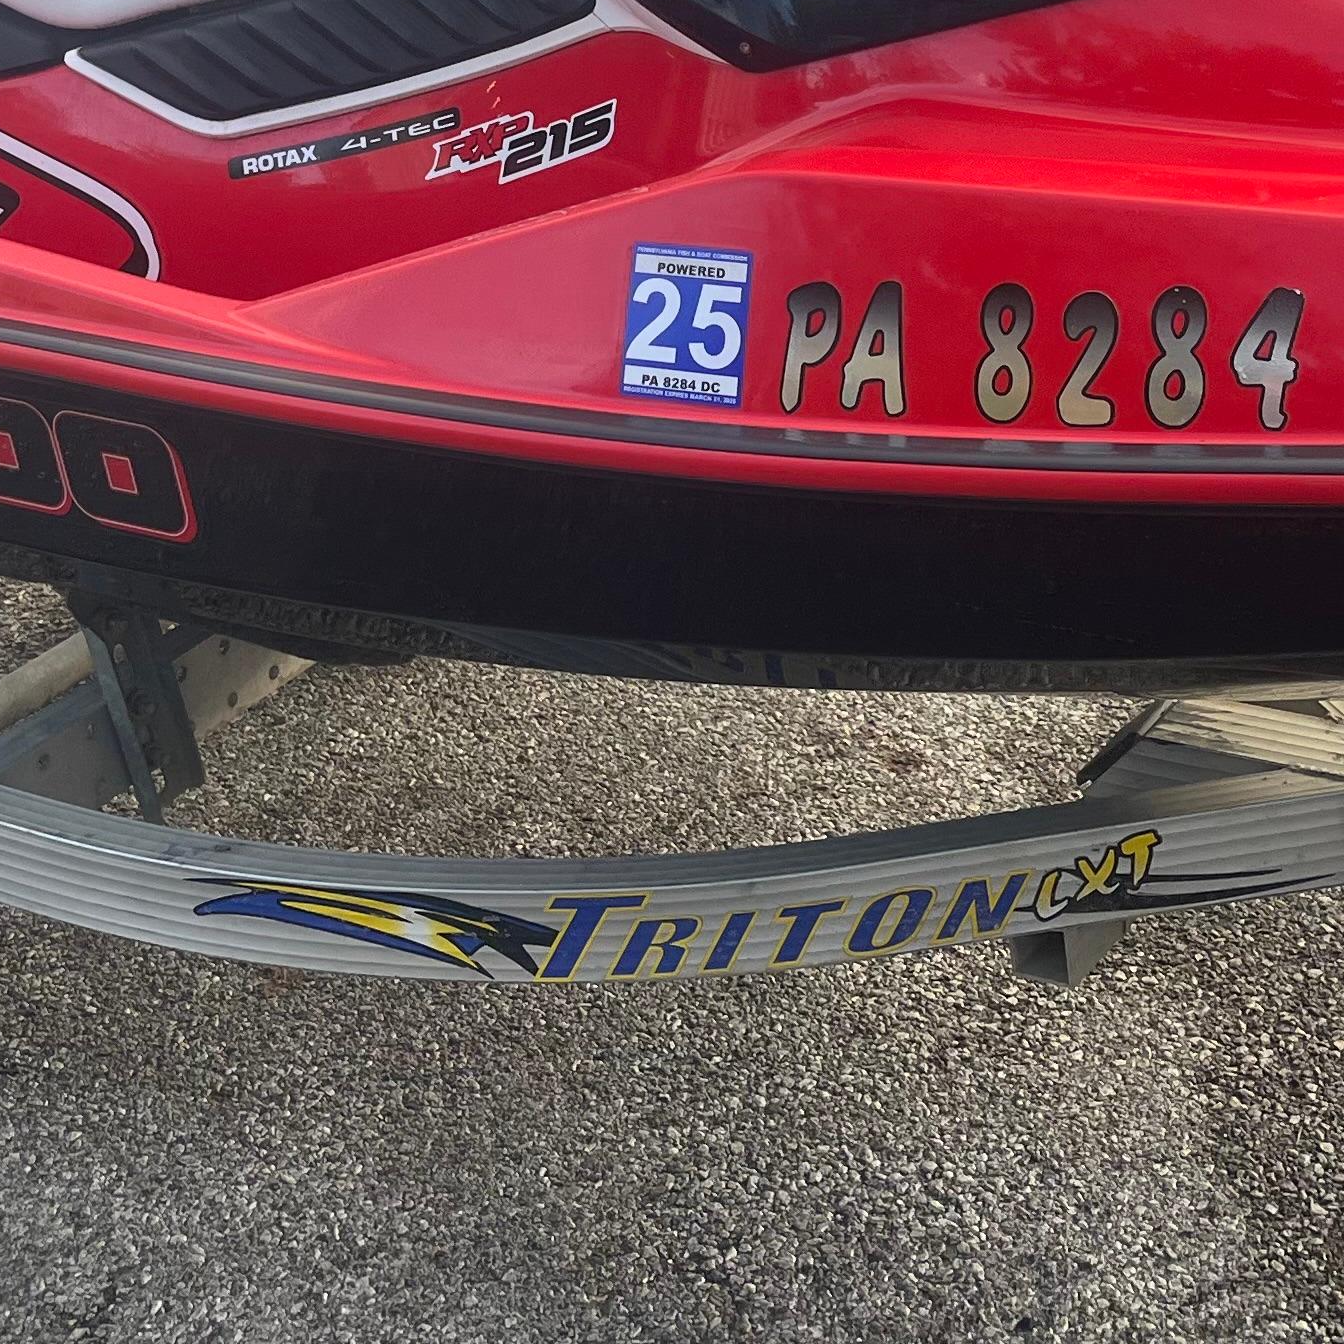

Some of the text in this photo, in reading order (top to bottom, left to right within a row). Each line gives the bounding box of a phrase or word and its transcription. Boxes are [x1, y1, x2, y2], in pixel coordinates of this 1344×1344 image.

[242, 113, 456, 175] ROTAX 4-TEC
[424, 98, 617, 184] RXP 215
[657, 262, 726, 278] POWERED
[625, 277, 743, 370] 25
[779, 280, 906, 417] PA
[973, 283, 1306, 432] 8284
[641, 374, 721, 393] PA 8284 DC
[533, 829, 1161, 984] TRITON CXT
